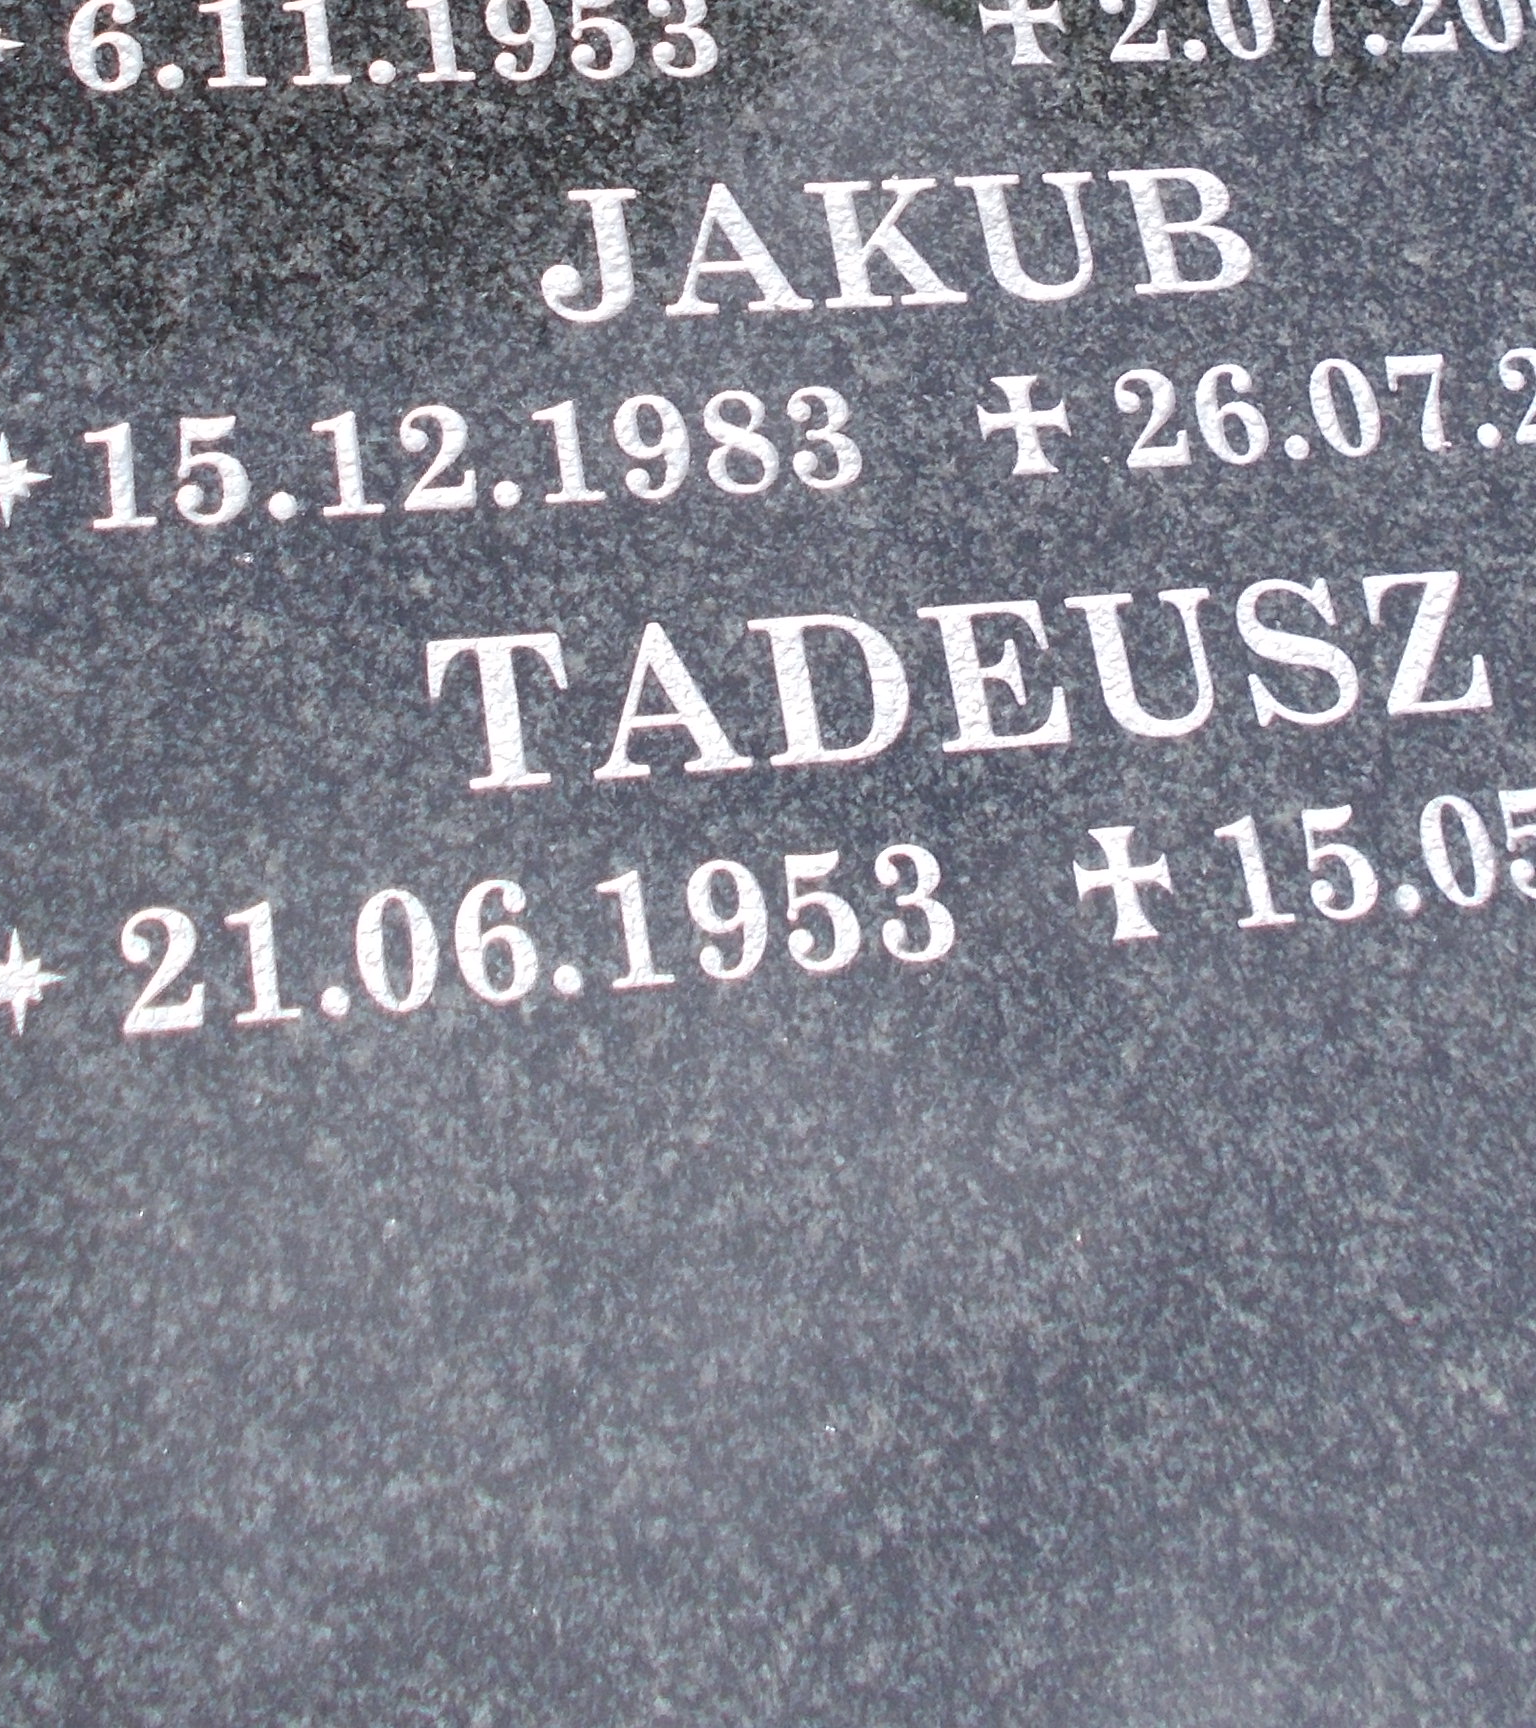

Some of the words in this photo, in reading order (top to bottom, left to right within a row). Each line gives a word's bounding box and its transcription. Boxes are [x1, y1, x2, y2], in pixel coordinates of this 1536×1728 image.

[538, 165, 1256, 327] JAKUB
[82, 383, 864, 531] 15.12.1983
[424, 568, 1494, 794] TADEUSZ
[118, 840, 957, 1039] 21.06.1953
